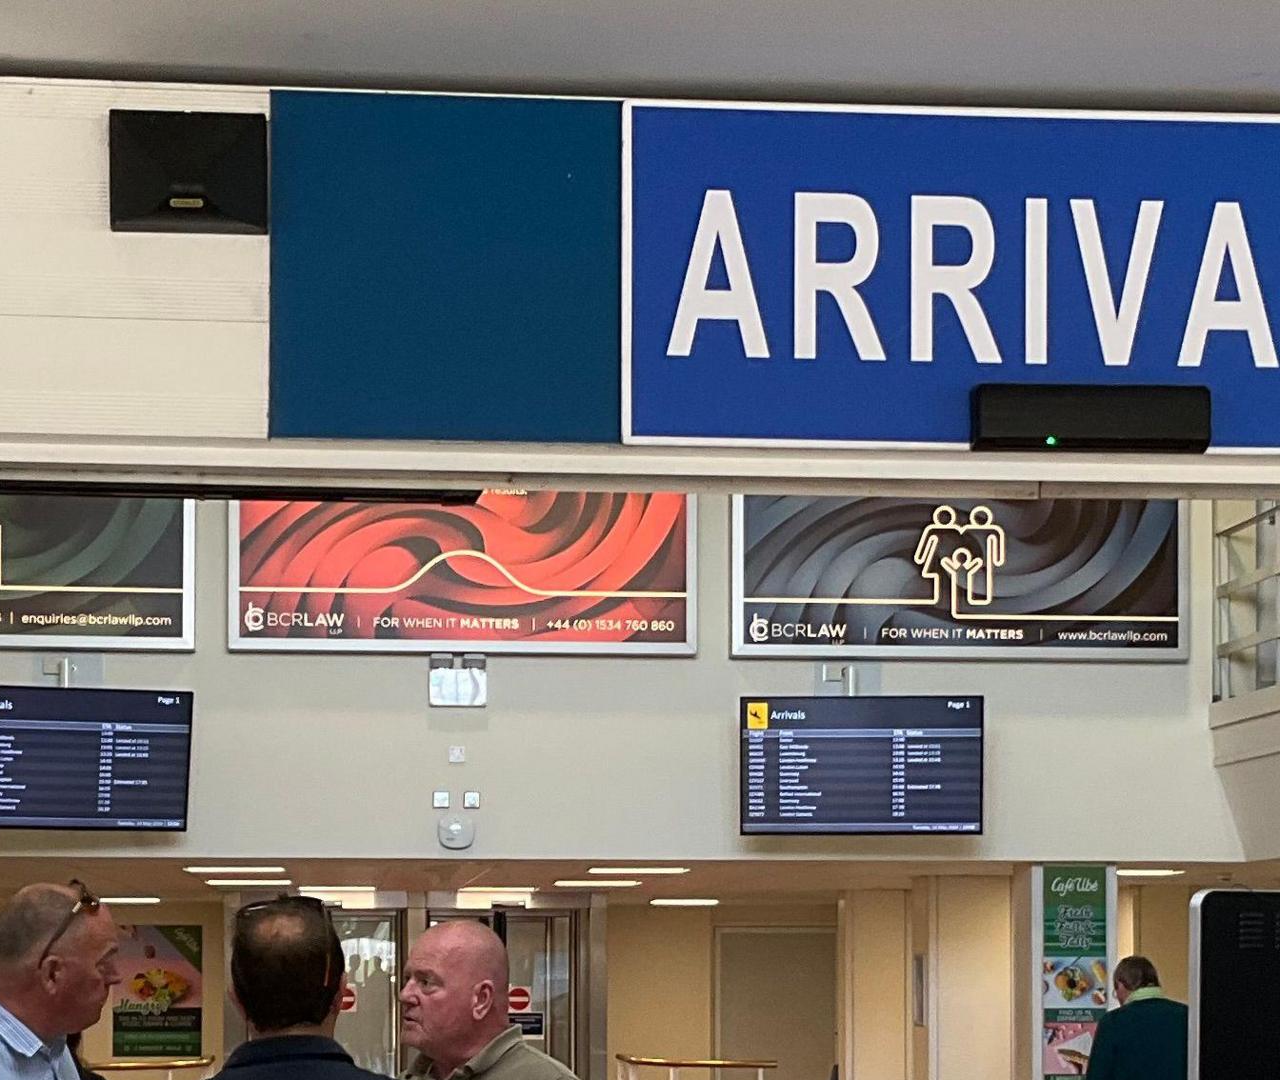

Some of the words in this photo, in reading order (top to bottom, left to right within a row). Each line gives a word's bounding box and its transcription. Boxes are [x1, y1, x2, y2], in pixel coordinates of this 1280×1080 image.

[21, 613, 172, 628] enquiries@bcrlawllp.com
[267, 611, 345, 628] BCRLAW
[373, 616, 400, 629] FOR
[403, 617, 444, 629] WHEN
[446, 618, 457, 629] IT
[460, 618, 519, 630] MATTERS
[546, 619, 570, 632] +44
[573, 618, 592, 633] (0)
[595, 619, 622, 632] 1534
[625, 620, 648, 632] 760
[650, 620, 675, 633] 860
[771, 623, 847, 638] BCRLAW
[881, 628, 907, 639] FOR
[910, 628, 949, 639] WHEN
[952, 628, 963, 639] IT
[966, 628, 1024, 640] MATTERS
[1057, 630, 1168, 642] www.bcrlawllp.com
[157, 696, 174, 705] Page
[770, 709, 806, 720] Arrivals
[947, 701, 964, 710] Page
